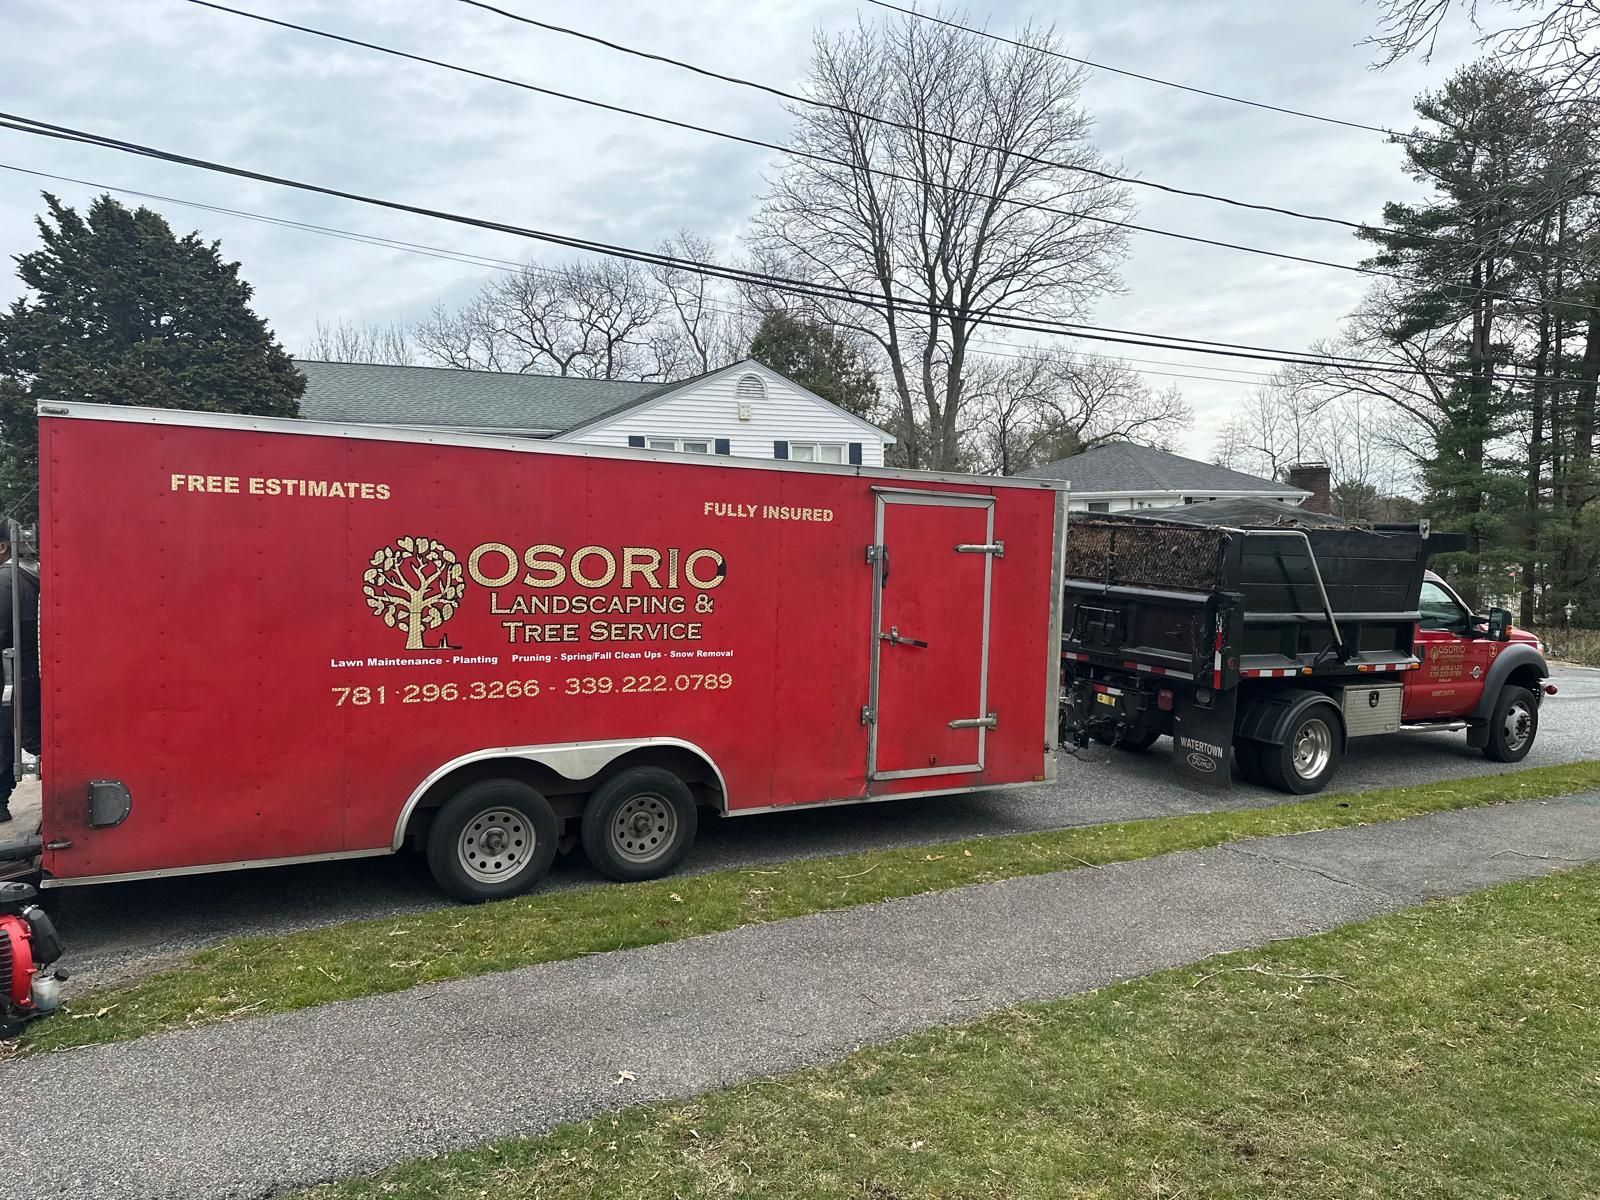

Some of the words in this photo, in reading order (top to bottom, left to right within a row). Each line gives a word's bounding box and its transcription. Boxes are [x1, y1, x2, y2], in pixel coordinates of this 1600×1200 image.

[171, 474, 240, 494] FREE
[249, 477, 391, 500] ESTIMATES
[704, 501, 758, 518] FULLY
[763, 505, 834, 521] INSURED
[694, 593, 715, 614] &
[502, 620, 580, 643] TREE
[589, 620, 703, 642] SERVICE
[331, 658, 363, 667] Lawn
[367, 656, 443, 667] Maintenance
[453, 655, 498, 665] Planting
[512, 654, 551, 663] Pruning
[560, 652, 611, 662] Spring/Fall
[614, 651, 641, 659] Clean
[644, 651, 662, 660] Ups
[670, 650, 694, 658] Snow
[696, 649, 734, 657] Removal
[1438, 645, 1466, 654] OSORIO
[565, 673, 733, 695] 339.222.0789
[1180, 736, 1223, 758] WATERTOWN
